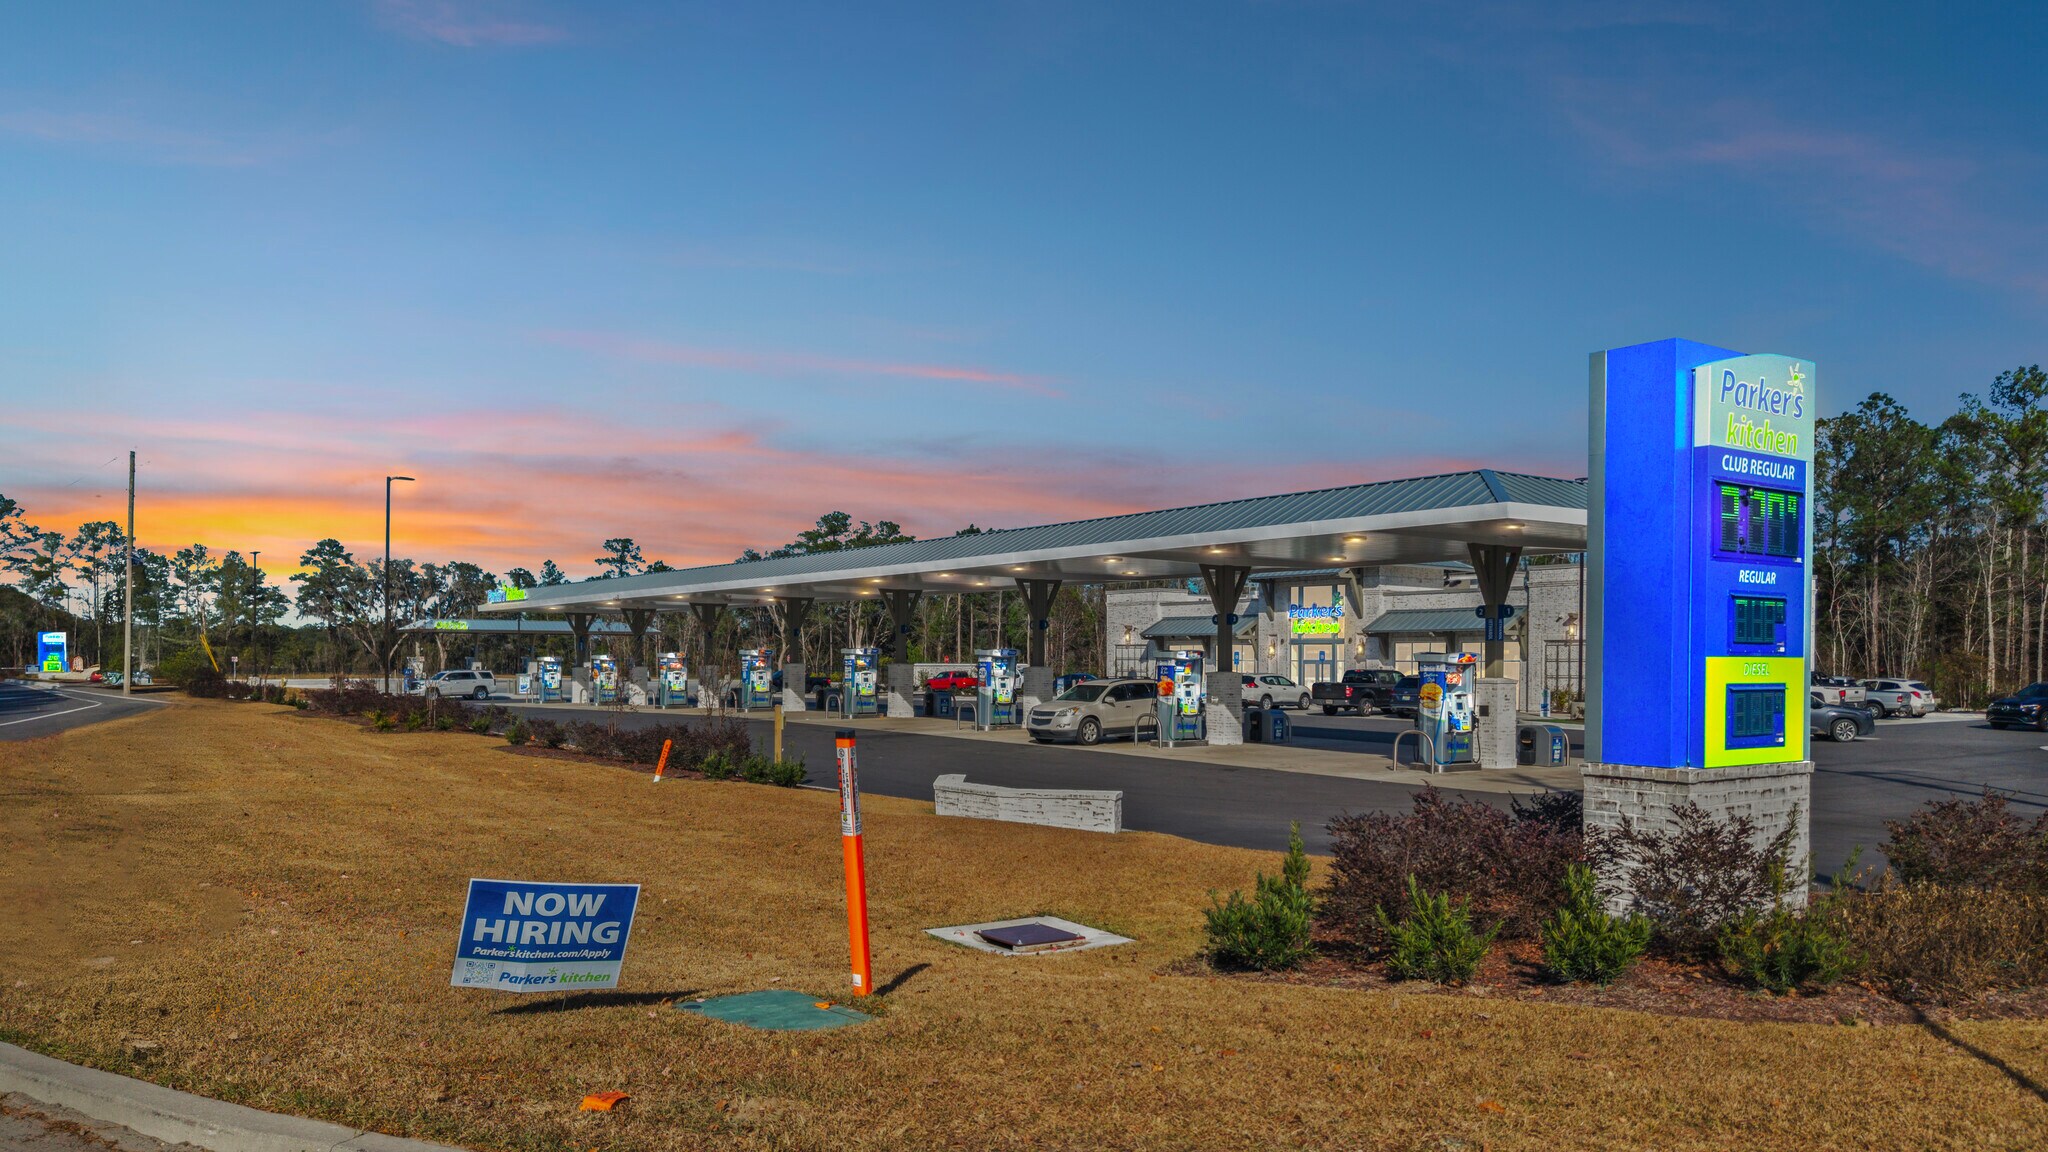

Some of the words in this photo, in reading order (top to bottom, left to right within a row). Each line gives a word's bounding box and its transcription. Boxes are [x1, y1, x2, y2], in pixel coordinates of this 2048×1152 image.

[1726, 412, 1798, 456] kitchen
[1722, 455, 1748, 475] CLUB
[1750, 459, 1796, 480] REGULAR
[1739, 569, 1777, 585] REGULAR
[1292, 619, 1340, 634] kitchen
[1743, 663, 1770, 676] DIESEL
[502, 891, 607, 917] NOW
[473, 918, 621, 945] HIRING
[560, 971, 610, 983] kitchen
